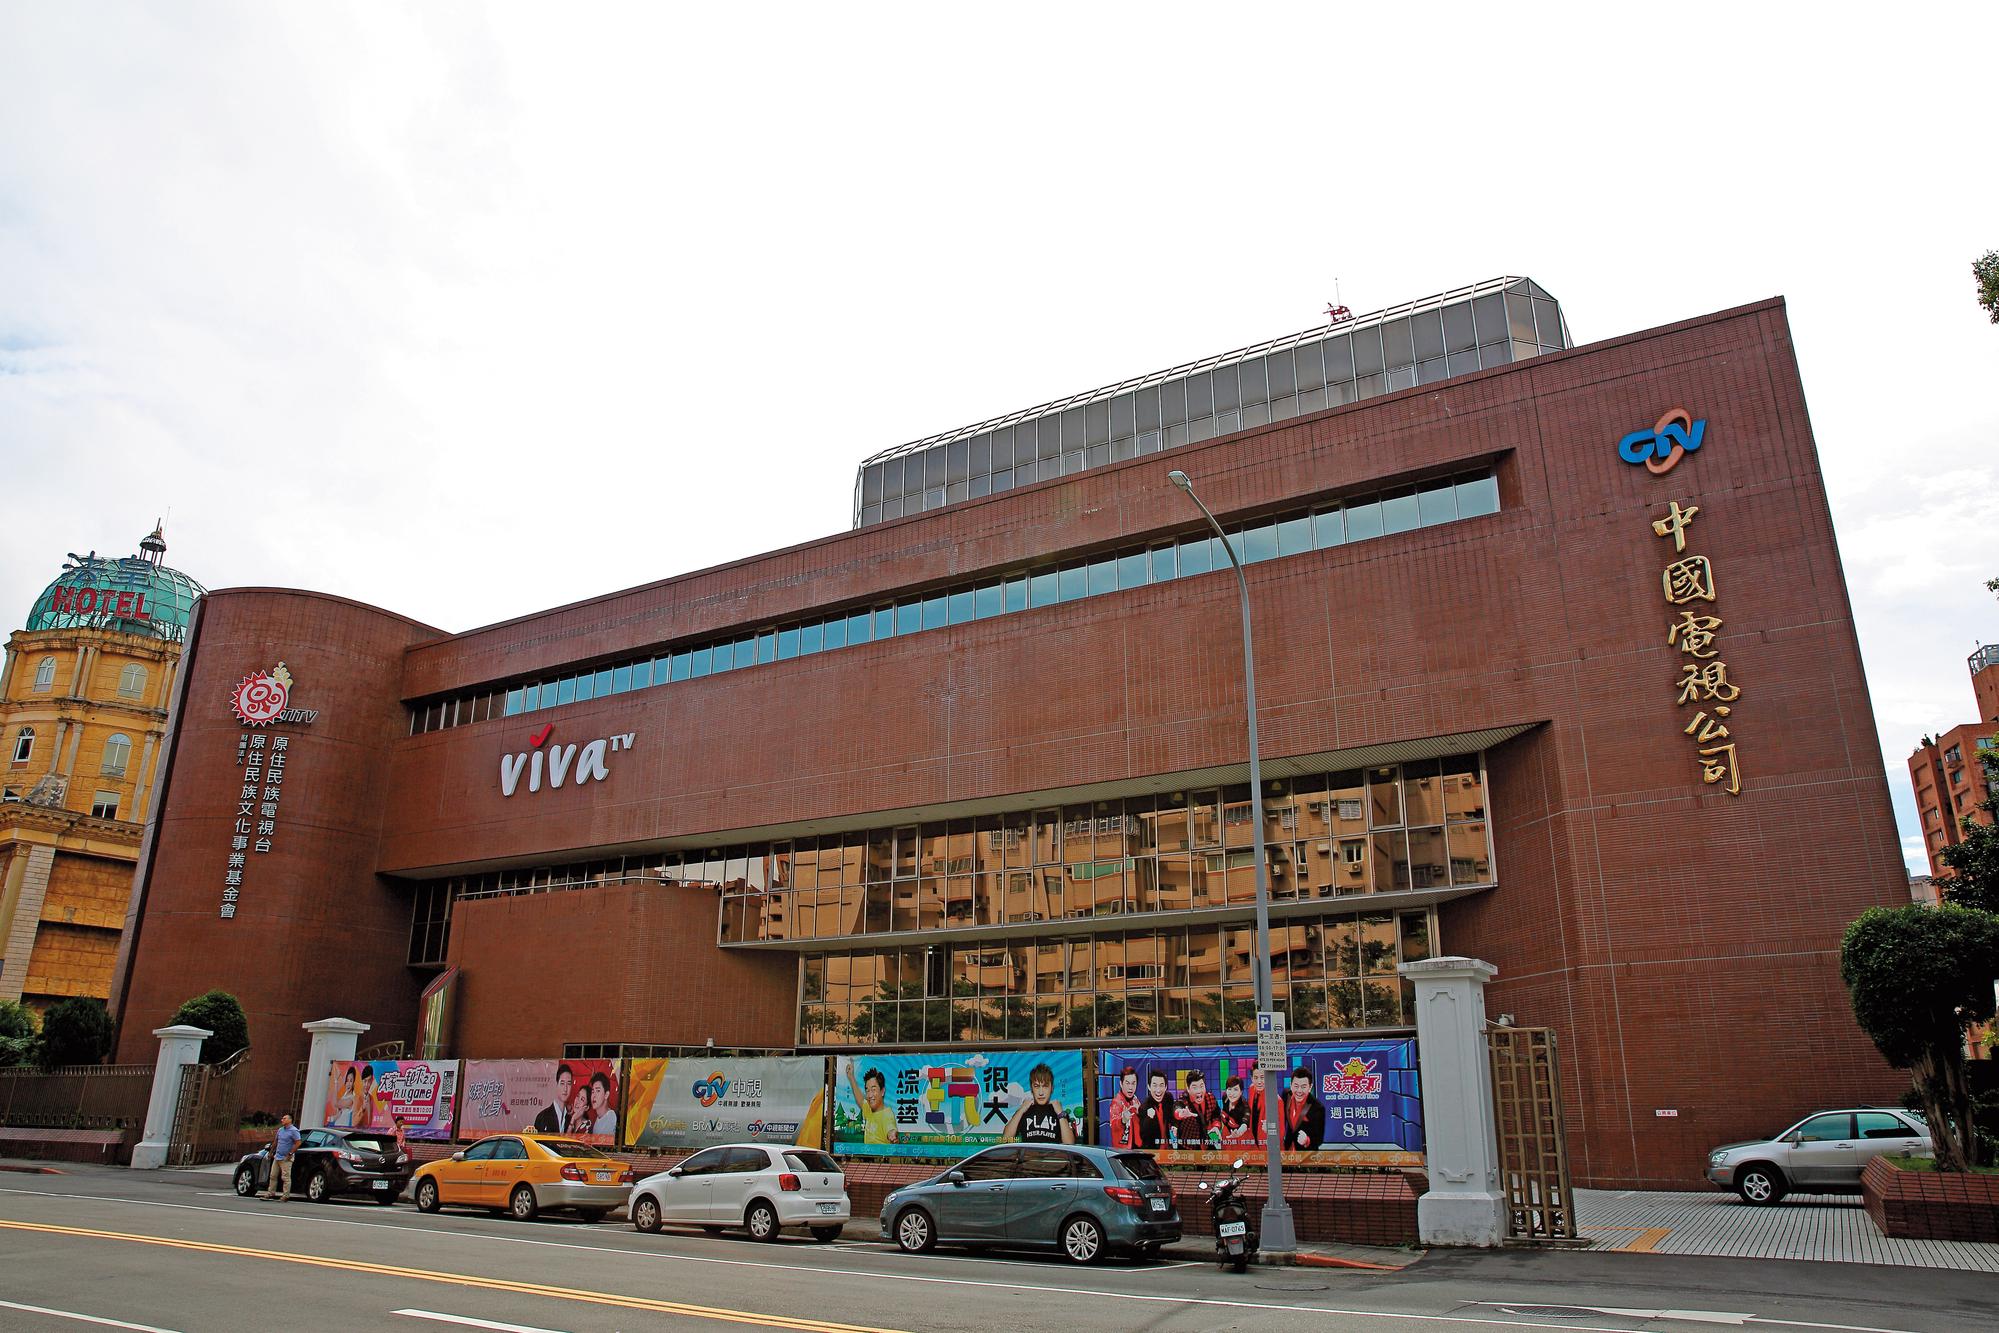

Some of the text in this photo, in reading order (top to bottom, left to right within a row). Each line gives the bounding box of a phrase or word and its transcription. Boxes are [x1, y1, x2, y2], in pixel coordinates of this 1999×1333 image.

[52, 585, 151, 620] HOTEL
[1652, 501, 1742, 796] 中國電視公司
[501, 723, 636, 797] viva TV
[254, 736, 290, 853] 原住民族電視台
[219, 734, 267, 919] 原住民族文化事業基金會
[1260, 1016, 1270, 1029] P
[732, 1078, 763, 1098] 中視
[896, 1068, 920, 1124] 綜藝
[983, 1066, 1009, 1125] 很大
[692, 1118, 723, 1132] BRAVO
[1026, 1114, 1057, 1131] PLAY
[1330, 1106, 1379, 1119] 週日晚間
[1343, 1122, 1369, 1138] 8點
